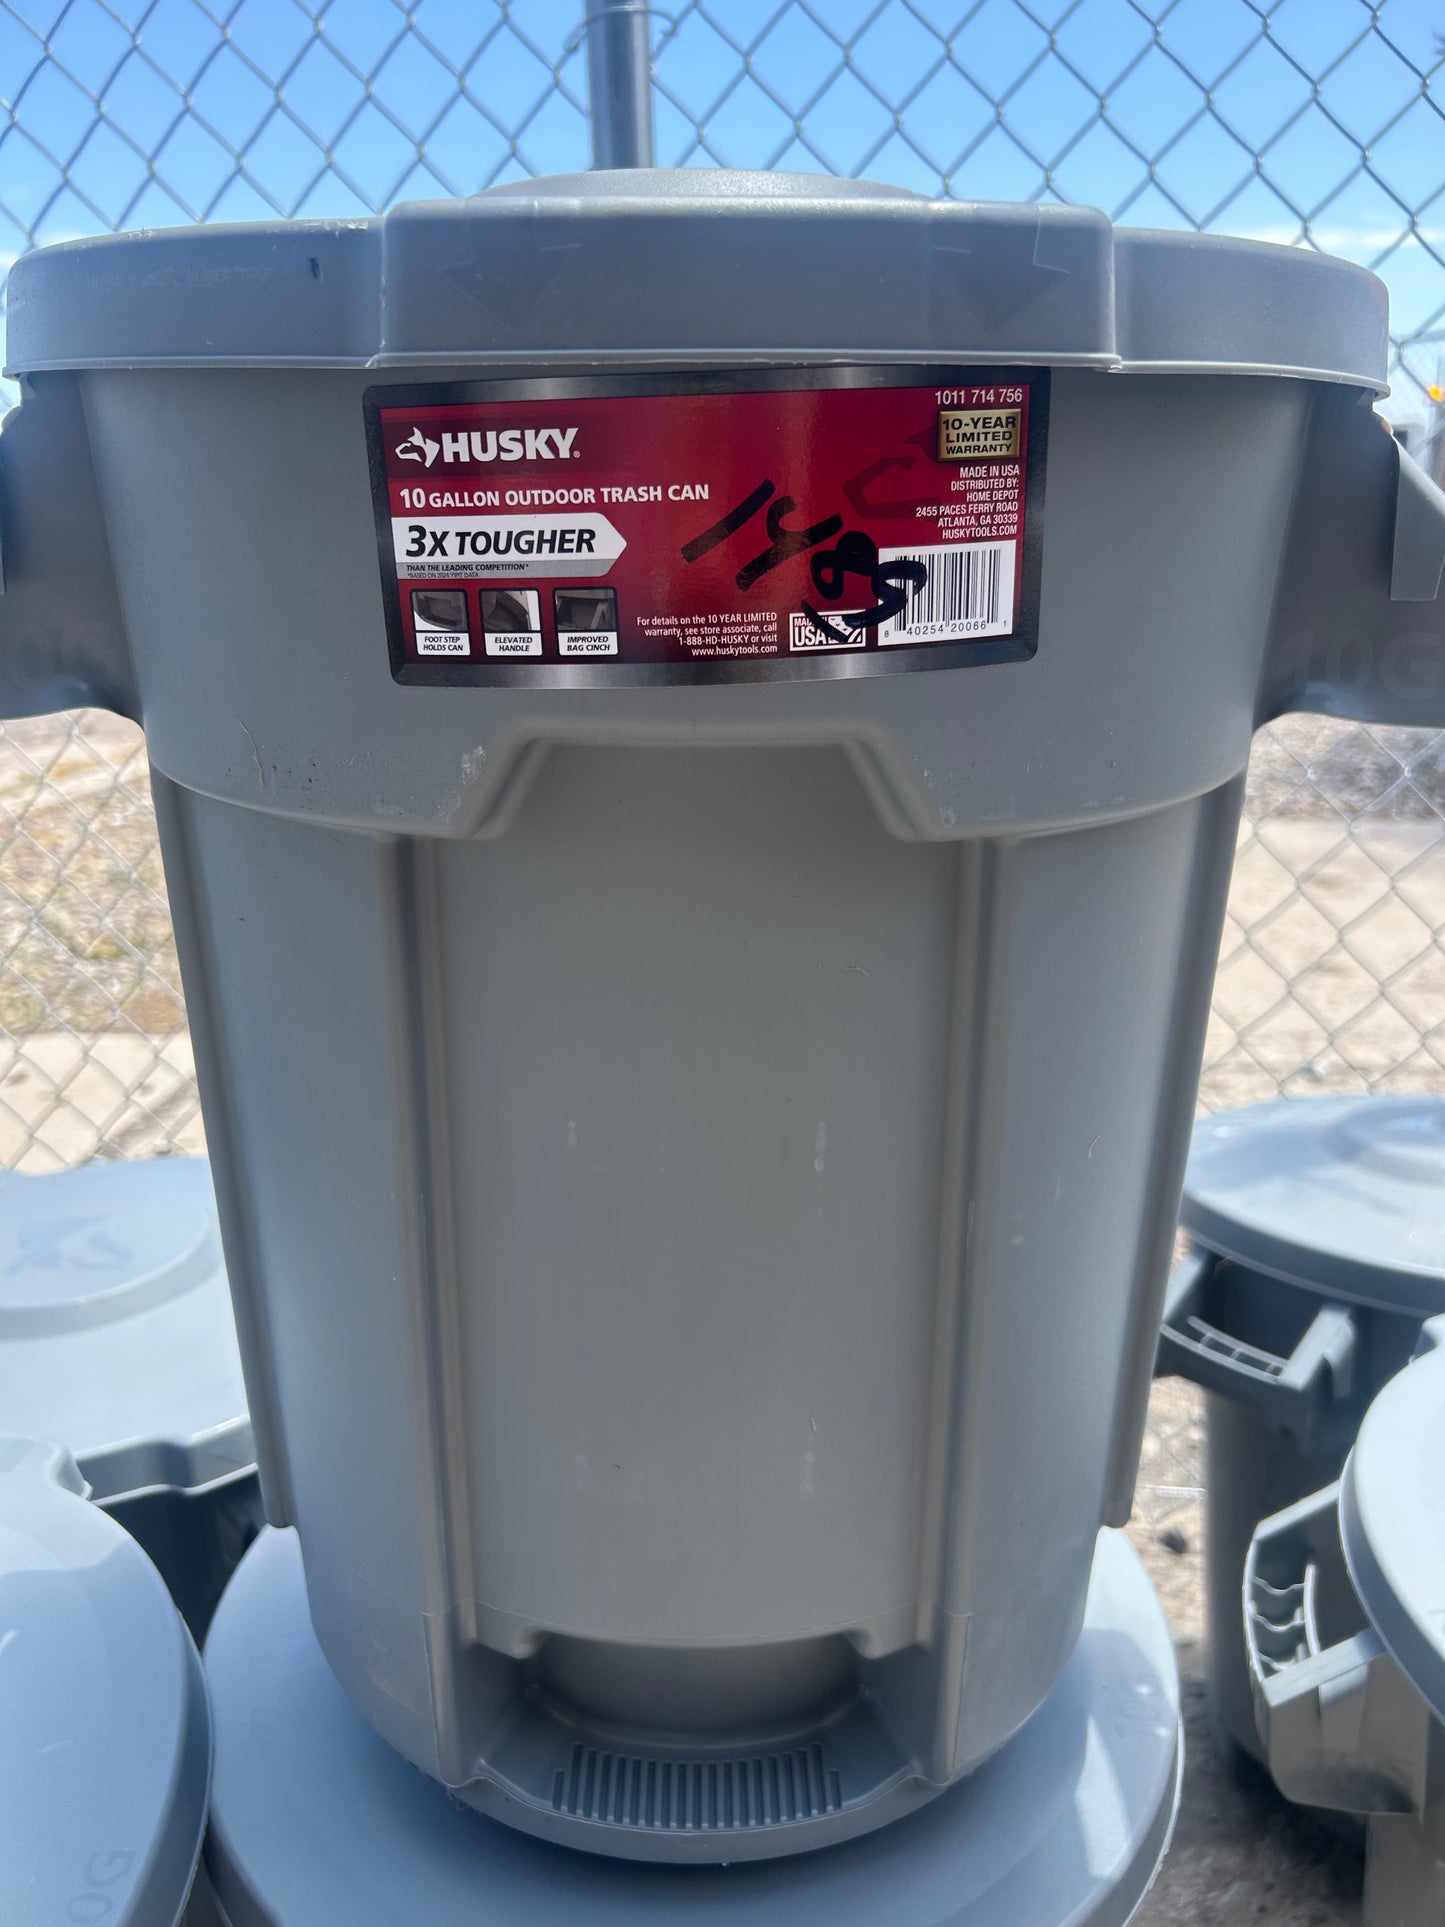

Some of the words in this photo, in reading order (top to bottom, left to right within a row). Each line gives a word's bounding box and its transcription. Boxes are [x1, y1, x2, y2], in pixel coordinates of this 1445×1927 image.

[935, 390, 965, 405] 1011
[971, 389, 995, 403] 714
[999, 388, 1023, 403] 756
[942, 416, 1016, 430] 10-YEAR
[945, 431, 1012, 443] LIMITED
[945, 443, 1012, 455] WARRANTY
[960, 466, 988, 478] MADE
[989, 466, 999, 477] IN
[1001, 464, 1019, 476] USA
[951, 478, 1004, 491] DISTRIBUTED
[1006, 478, 1019, 488] BY:
[399, 488, 426, 509] 10
[428, 490, 500, 508] GALLON
[504, 487, 596, 506] OUTDOOR
[600, 485, 662, 503] TRASH
[667, 483, 709, 501] CAN
[966, 490, 990, 502] HOME
[992, 489, 1018, 500] DEPOT
[916, 505, 937, 518] 2455
[939, 504, 966, 516] PACES
[968, 502, 994, 514] FERRY
[996, 501, 1018, 513] ROAD
[937, 515, 978, 528] ATLANTA,
[979, 514, 992, 525] GA
[993, 513, 1018, 524] 30339
[942, 525, 1017, 539] HUSKYTOOLS.COM
[405, 524, 450, 557] 3X
[455, 528, 596, 556] TOUGHER
[637, 617, 650, 626] For
[651, 616, 678, 625] details
[692, 615, 706, 624] the
[707, 615, 717, 623] 10
[719, 613, 742, 623] YEAR
[743, 612, 777, 622] LIMITED
[644, 627, 683, 637] warranty,
[700, 626, 720, 634] store
[722, 624, 762, 633] associate,
[763, 623, 777, 632] call
[795, 625, 827, 646] USA
[883, 630, 890, 638] 8
[906, 623, 944, 636] 40254
[950, 620, 987, 633] 20066
[679, 634, 749, 646] 1-888-HD-HUSKY
[760, 634, 777, 642] visit
[691, 645, 778, 656] www.huskytools.com
